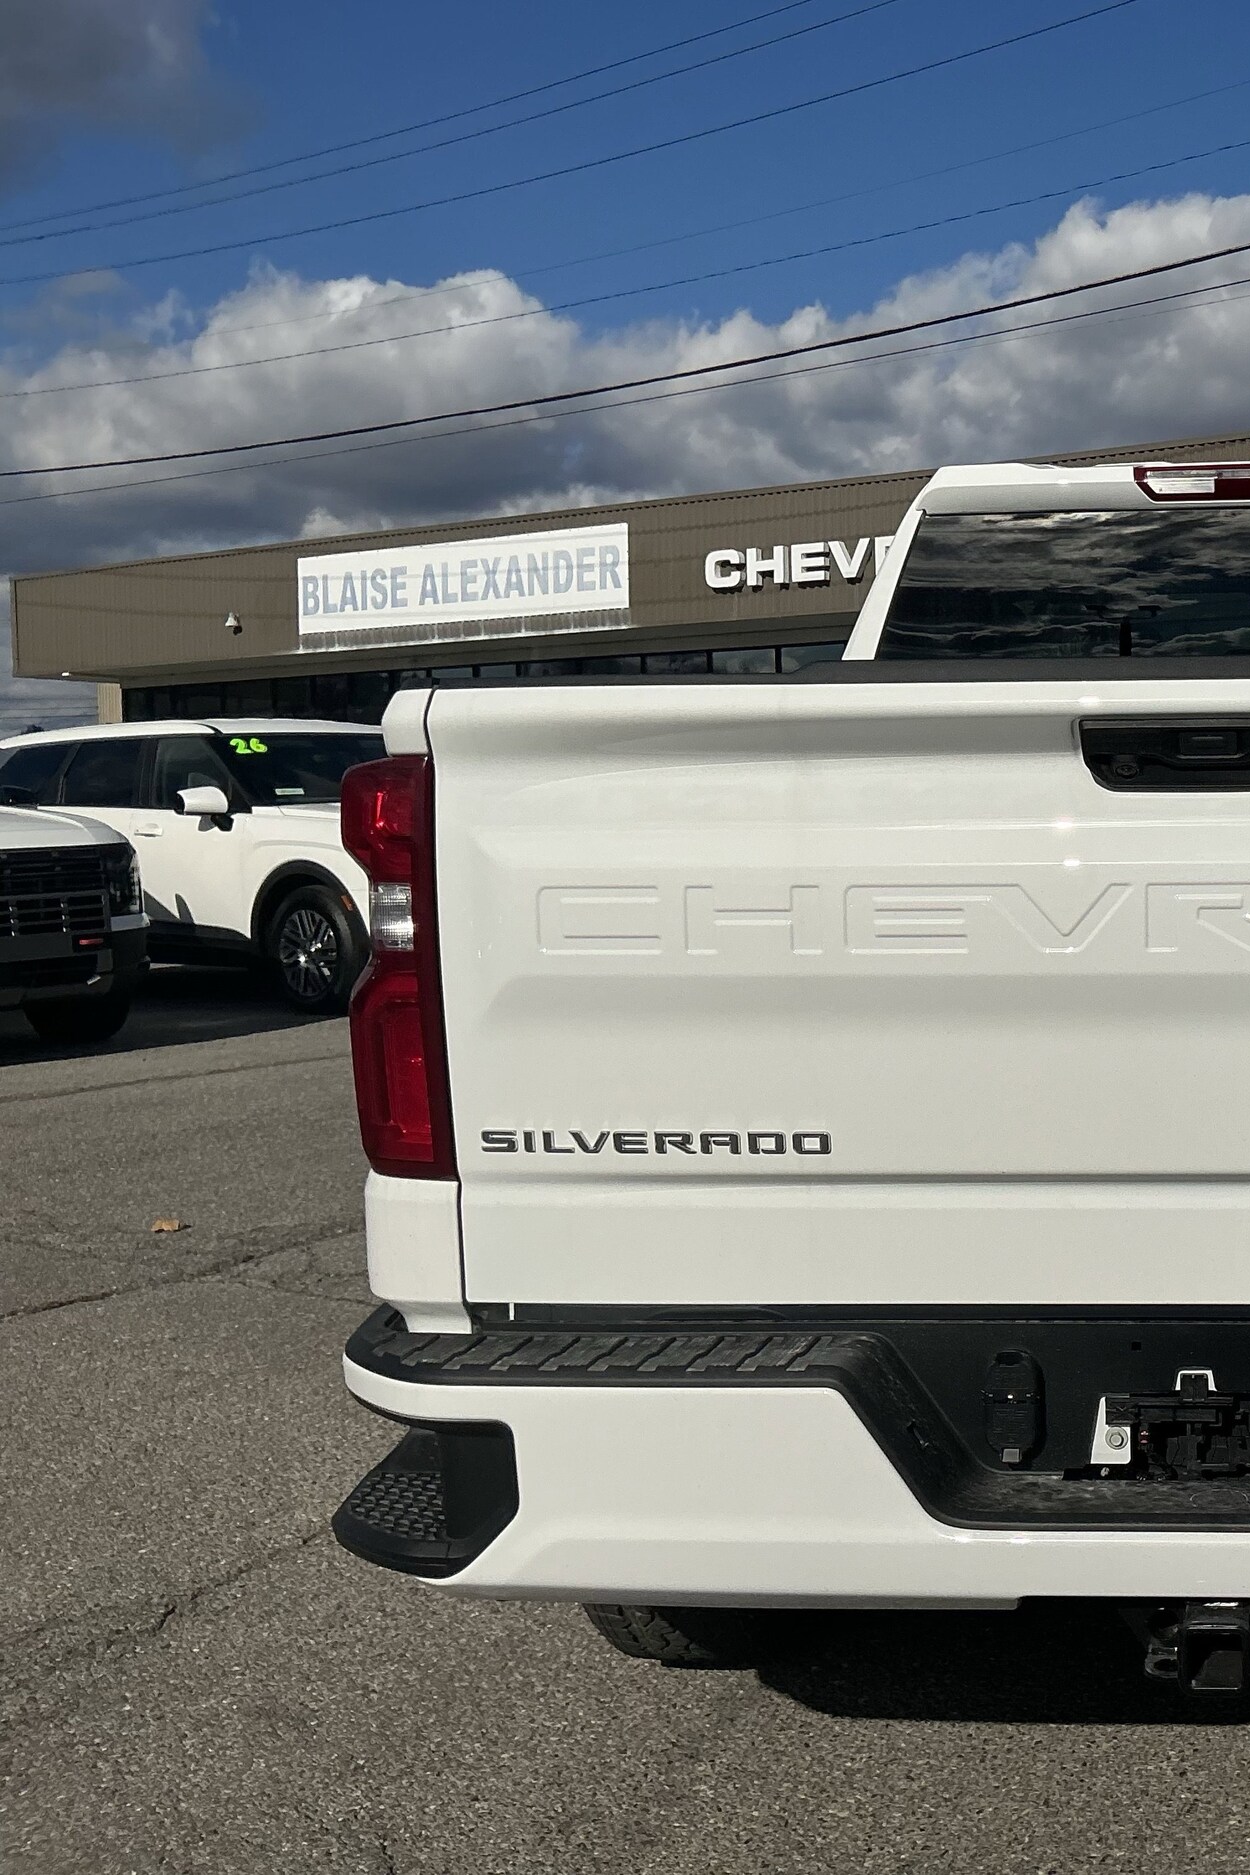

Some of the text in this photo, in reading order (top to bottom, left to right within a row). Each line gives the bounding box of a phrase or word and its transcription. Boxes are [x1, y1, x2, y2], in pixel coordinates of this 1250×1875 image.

[302, 544, 622, 616] BLAISE ALEXANDER
[230, 738, 268, 754] 26
[480, 1129, 833, 1155] SILVERADO
